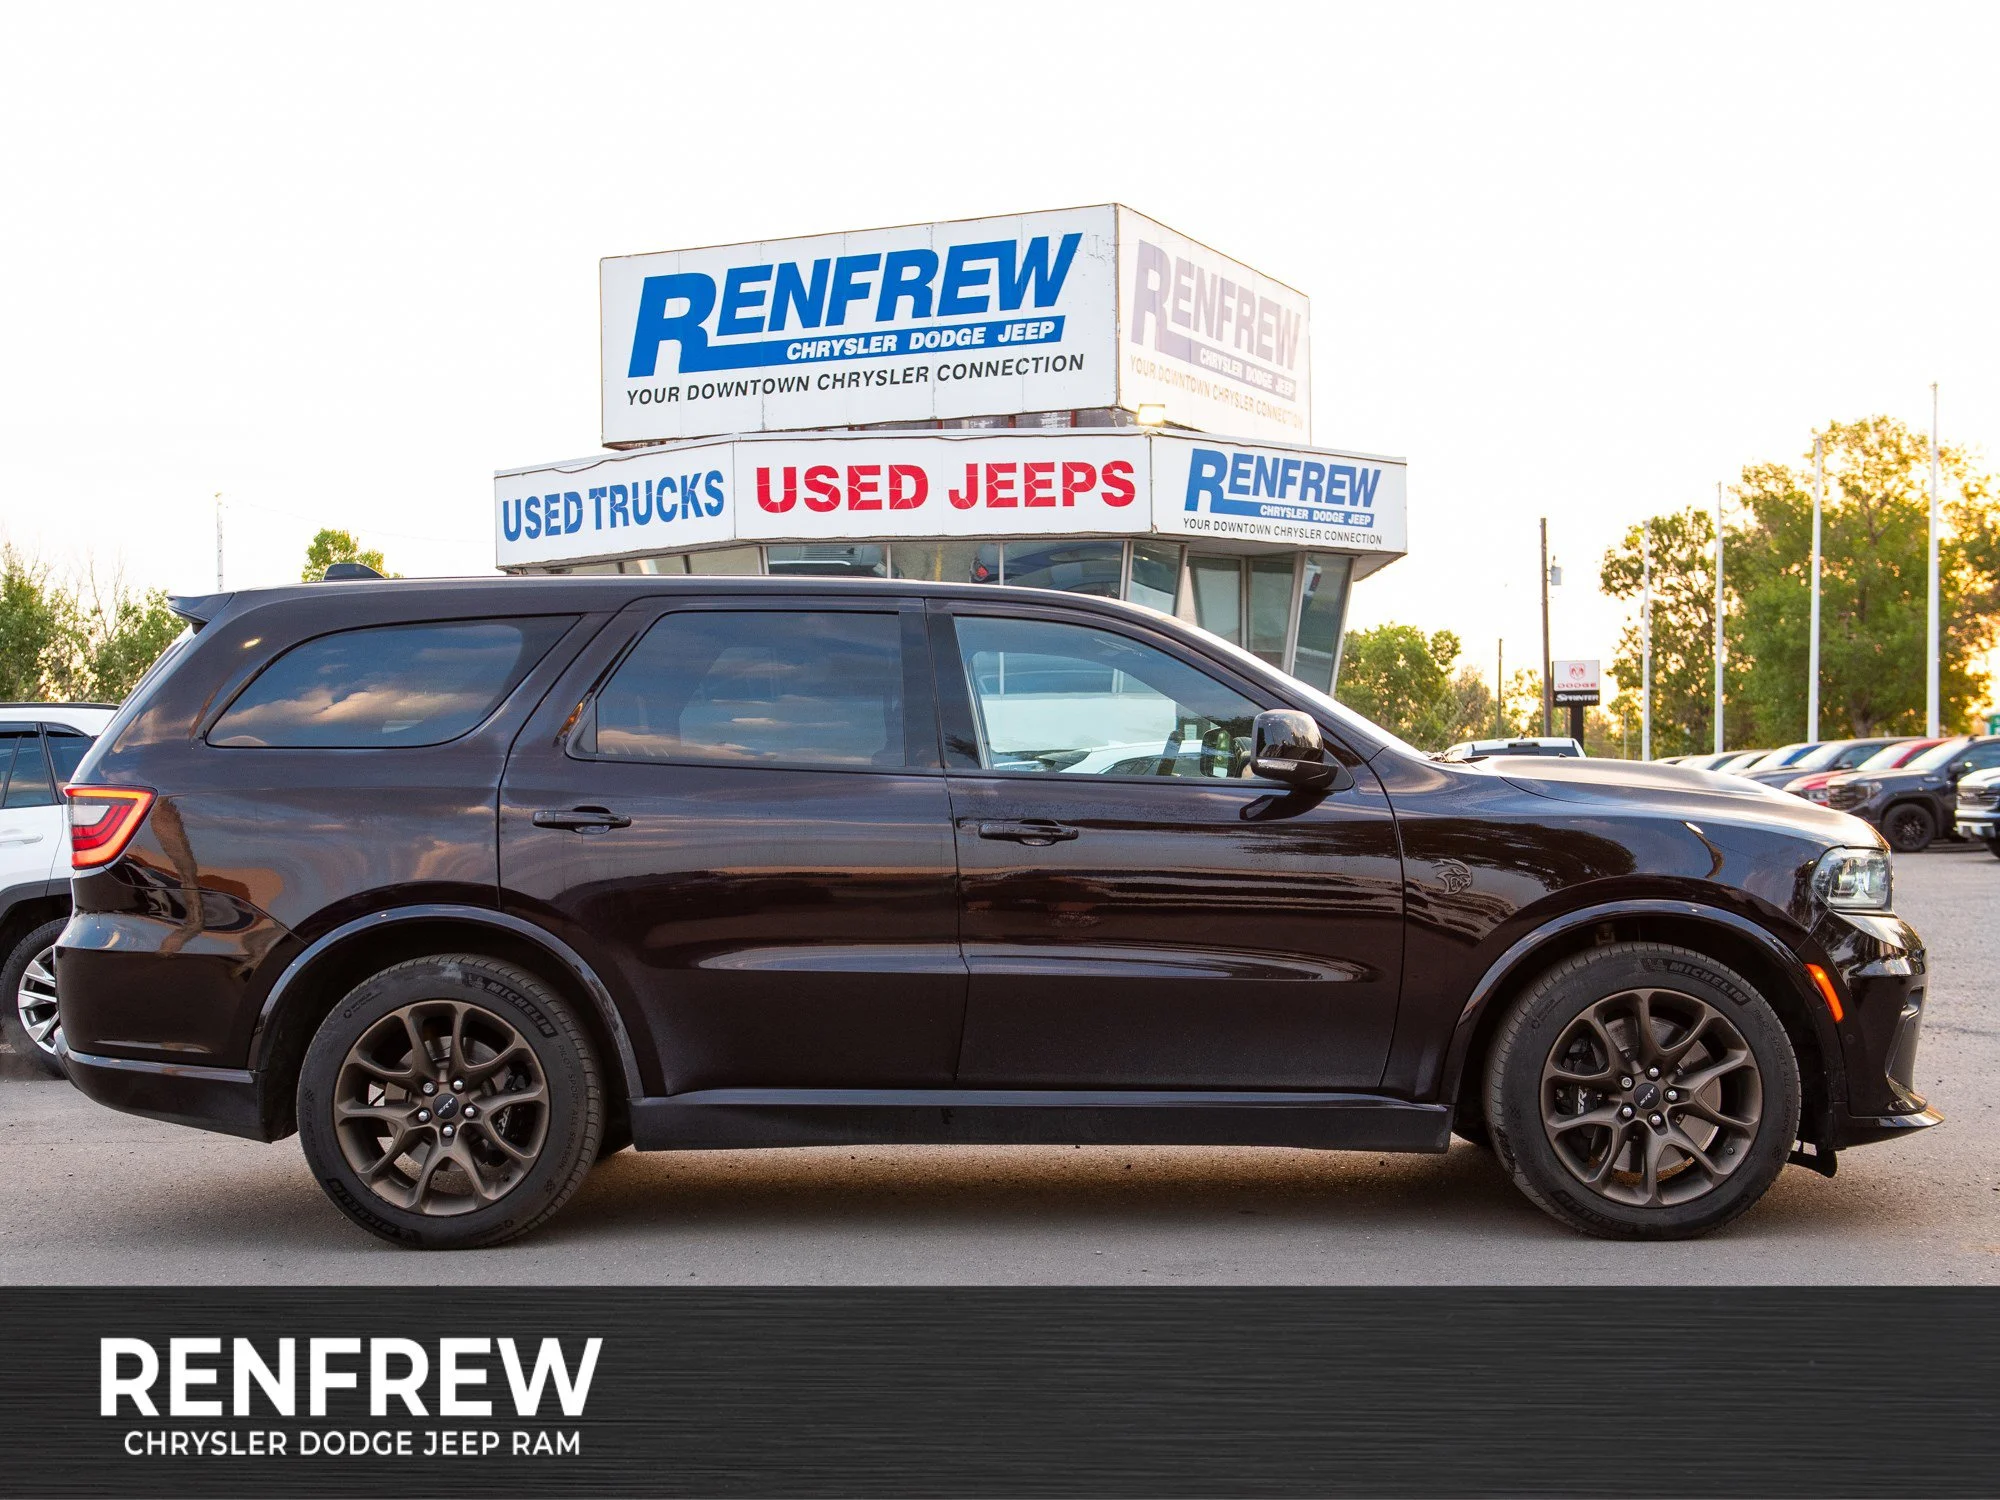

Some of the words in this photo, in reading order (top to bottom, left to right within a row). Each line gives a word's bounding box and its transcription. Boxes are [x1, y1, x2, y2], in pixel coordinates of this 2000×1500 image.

[627, 232, 1083, 378] RENFREW
[1131, 239, 1301, 371] RENFREW
[786, 335, 897, 361] CHRYSLER
[909, 327, 985, 350] DODGE
[998, 321, 1055, 344] JEEP
[627, 385, 680, 406] YOUR
[687, 375, 809, 401] DOWNTOWN
[817, 366, 929, 391] CHRYSLER
[937, 353, 1085, 382] CONNECTION
[1130, 354, 1156, 379] YOUR
[1158, 366, 1211, 397] DOWNTOWN
[1212, 382, 1254, 410] CHRYSLER
[1256, 399, 1303, 430] CONNECTON
[1199, 347, 1243, 377] CHRYSLER
[1246, 365, 1273, 390] DODGE
[1275, 375, 1295, 395] JEEP
[502, 491, 583, 542] USED
[588, 469, 725, 527] TRUCKS
[756, 464, 929, 514] USED
[948, 460, 1136, 509] JEEPS
[1184, 447, 1382, 512] RENFREW
[1183, 517, 1211, 531] YOUR
[1213, 520, 1272, 536] DOWNTOWN
[1274, 525, 1322, 540] CHRYSLER
[1324, 530, 1382, 545] CONNECTION
[1260, 504, 1309, 520] CHRYSLER
[1312, 509, 1345, 524] DODGE
[1348, 513, 1371, 526] JEEP
[486, 981, 554, 1036] MICHELIN
[1670, 961, 1746, 1002] MICHELIN
